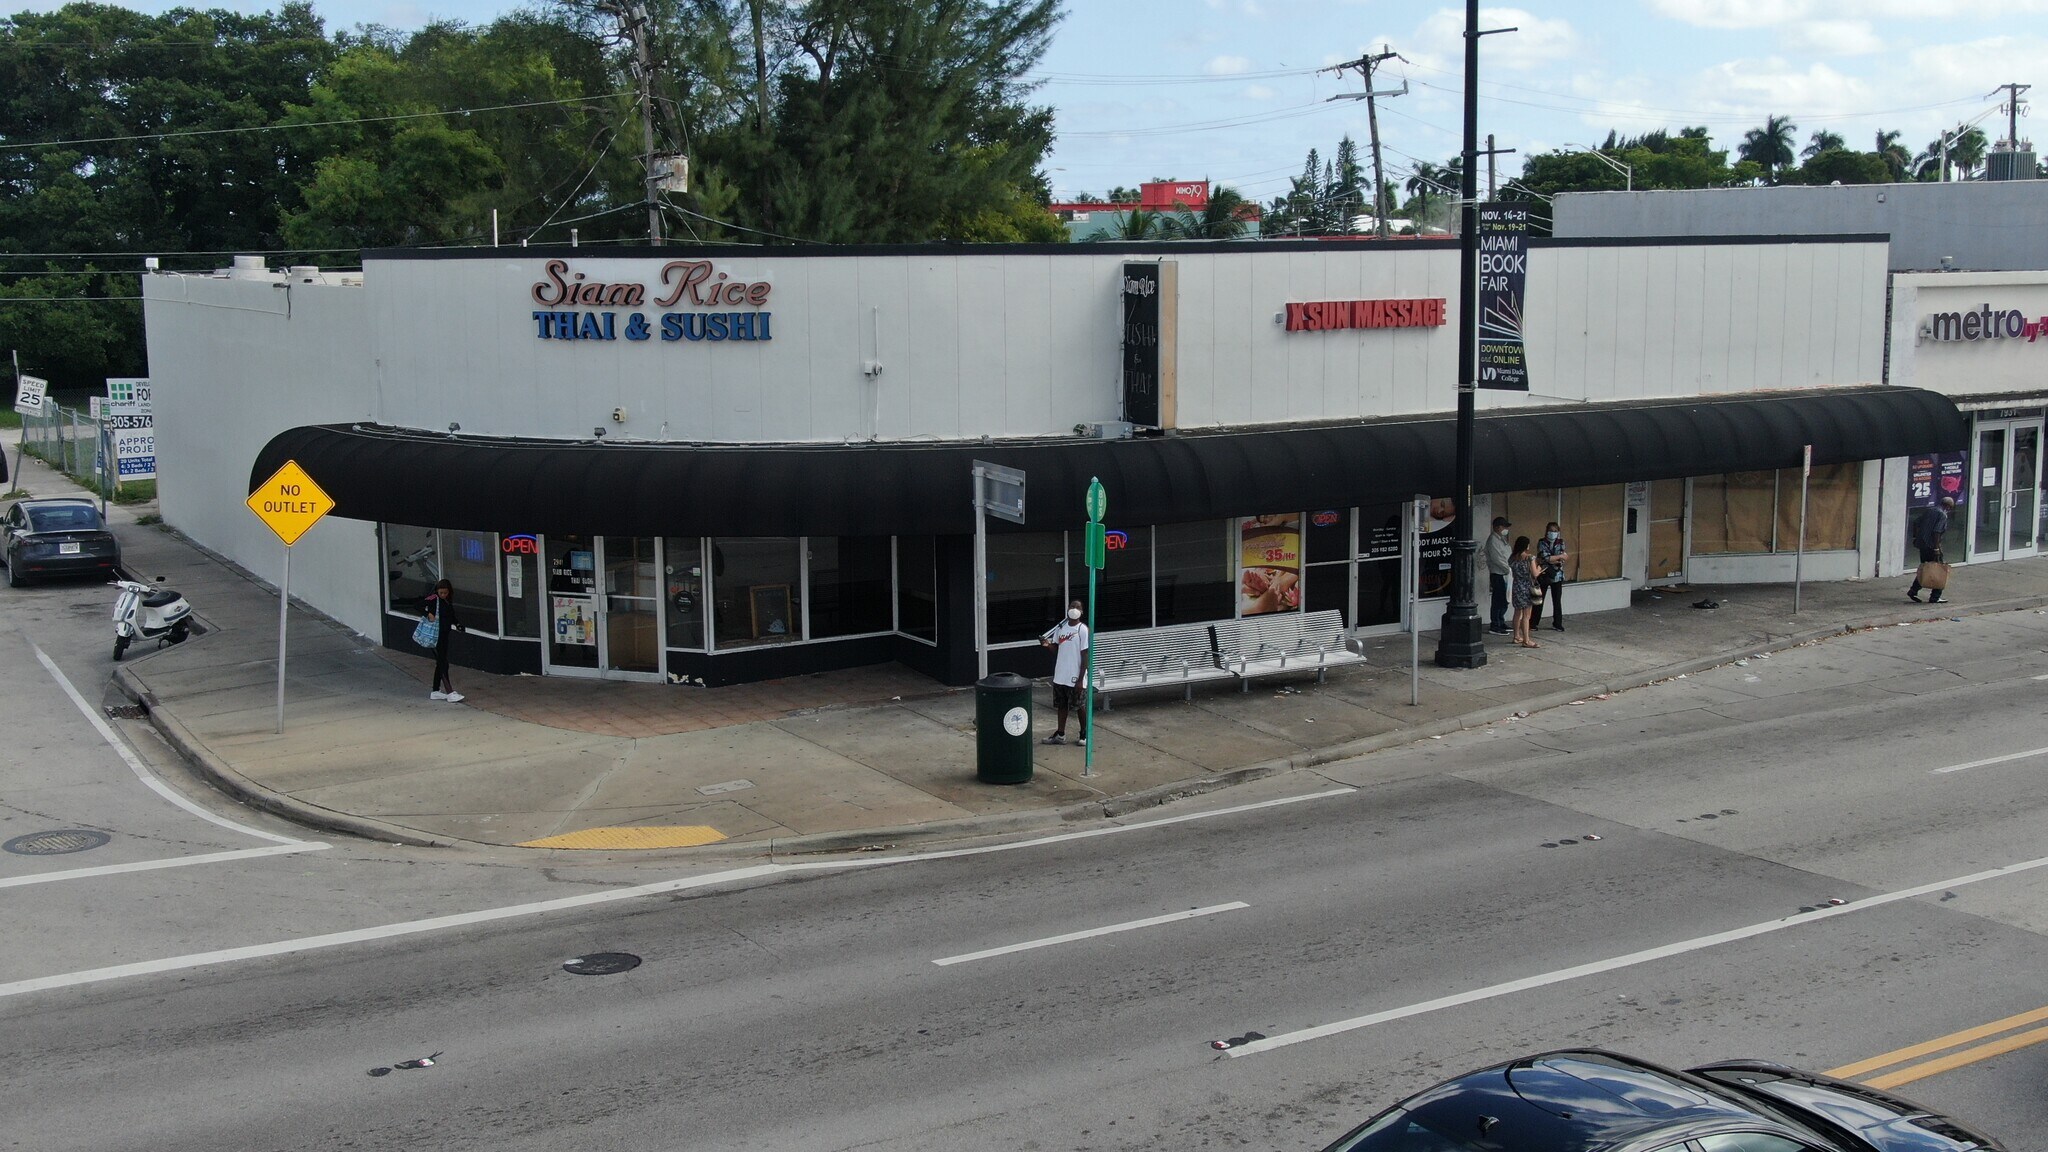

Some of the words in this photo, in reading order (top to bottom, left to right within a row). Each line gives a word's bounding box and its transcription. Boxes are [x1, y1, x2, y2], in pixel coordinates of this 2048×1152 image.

[1481, 211, 1502, 220] NOV.
[1503, 210, 1526, 220] 14-21
[1492, 223, 1507, 231] Nov.
[1508, 223, 1526, 231] 19-21
[1480, 236, 1518, 251] MIAMI
[1481, 254, 1525, 274] BOOK
[531, 260, 645, 306] Siam
[654, 260, 771, 306] Rice
[1480, 276, 1509, 291] FAIR
[1350, 298, 1447, 329] MASSAGE
[532, 311, 617, 340] THAI
[624, 312, 651, 341] &
[661, 311, 773, 341] SUSHI
[1928, 303, 2023, 341] metro
[1481, 344, 1525, 355] DOWNTOWN
[1493, 355, 1520, 364] ONLINE
[22, 379, 44, 389] SPEED
[23, 386, 42, 394] LIMIT
[20, 392, 40, 405] 25
[119, 436, 155, 446] APPRO
[119, 445, 153, 455] PROJE
[281, 485, 300, 496] NO
[264, 501, 316, 513] OUTLET
[502, 538, 538, 554] OPEN
